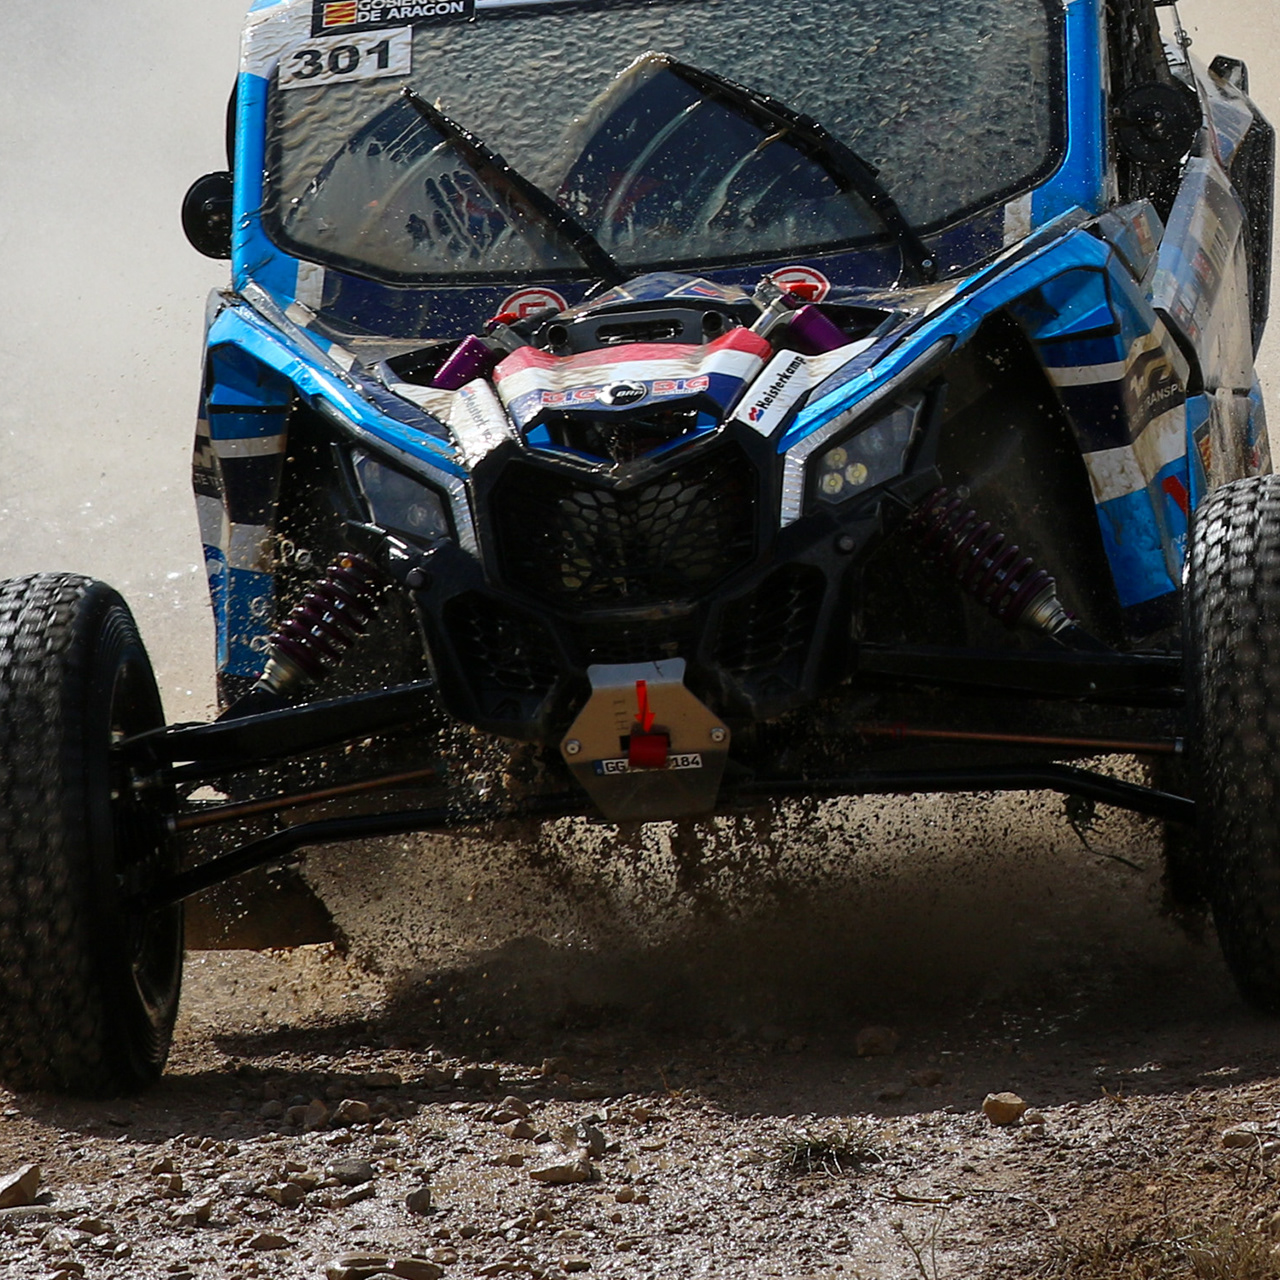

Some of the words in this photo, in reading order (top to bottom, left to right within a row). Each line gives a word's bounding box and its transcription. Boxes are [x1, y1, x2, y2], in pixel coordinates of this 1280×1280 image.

[357, 10, 382, 23] DE
[386, 1, 465, 19] ARAGON
[291, 40, 390, 79] 301
[652, 376, 709, 394] BIG
[755, 356, 807, 410] Heisterkamp
[672, 755, 700, 768] 184
